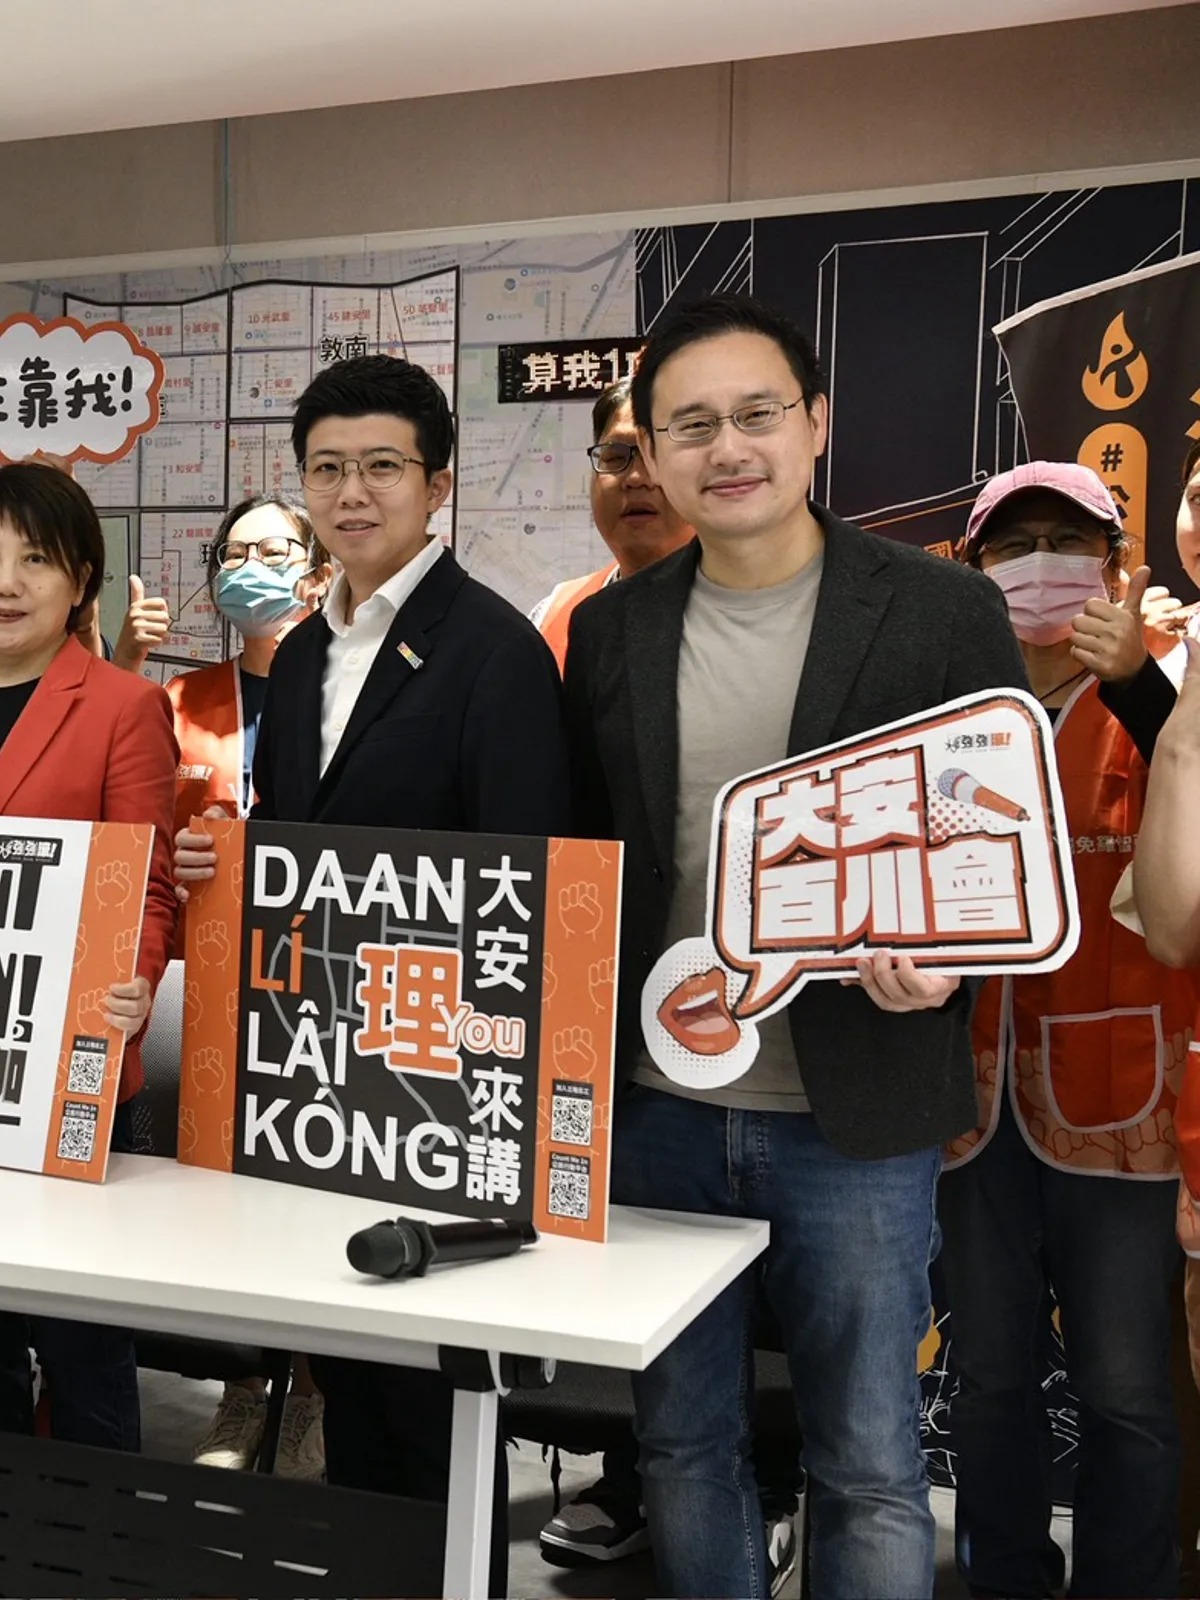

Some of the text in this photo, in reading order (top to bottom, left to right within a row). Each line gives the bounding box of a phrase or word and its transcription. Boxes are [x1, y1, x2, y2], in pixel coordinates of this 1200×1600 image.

[249, 314, 260, 323] 10
[320, 334, 368, 362] 敦南
[173, 529, 184, 538] 22
[755, 745, 926, 864] 大安
[253, 845, 466, 924] DAAN
[475, 855, 533, 993] 大安
[250, 914, 306, 994] LÍ
[246, 1000, 348, 1085] LÂI
[243, 1087, 460, 1190] KÓNG
[466, 1066, 525, 1206] 來講
